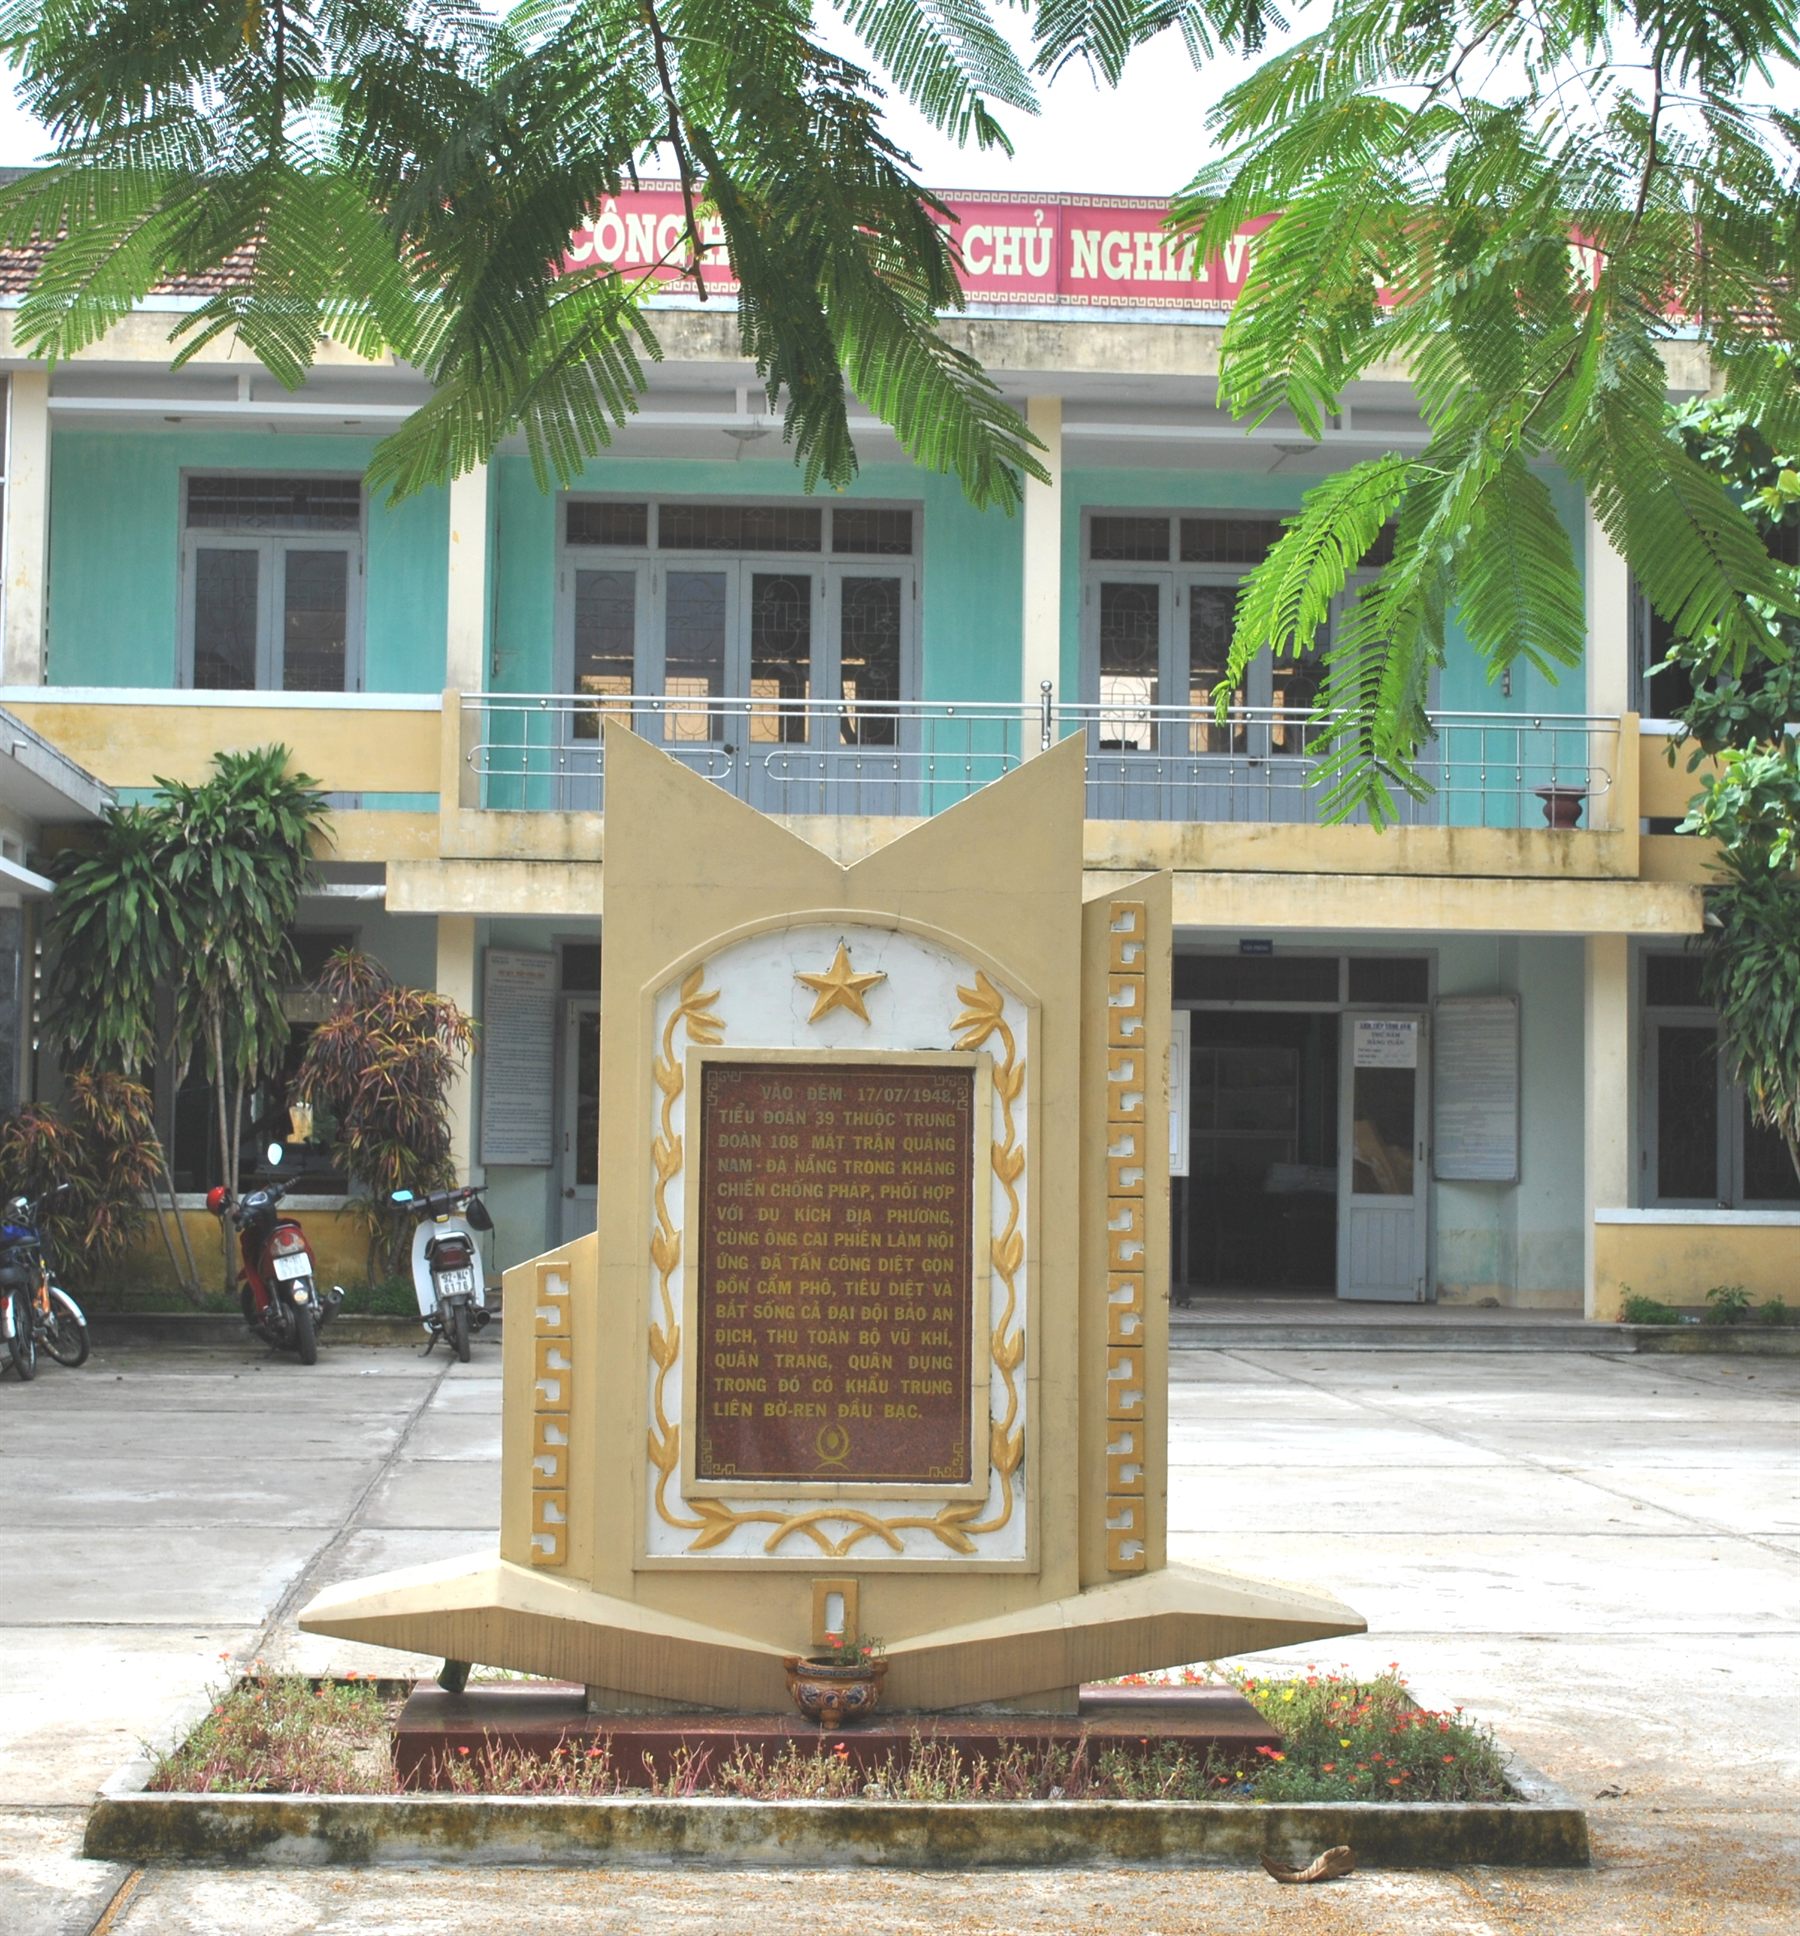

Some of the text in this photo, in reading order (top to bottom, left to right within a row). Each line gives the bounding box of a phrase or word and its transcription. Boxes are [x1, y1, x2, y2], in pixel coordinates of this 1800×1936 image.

[962, 208, 1053, 277] CHỦ
[762, 1082, 793, 1101] VÀO
[806, 1083, 843, 1102] ĐÊM
[719, 1102, 956, 1128] TIỂU ĐOÀN 39 THUỘC TRUNG
[718, 1131, 761, 1148] ĐOÀN
[770, 1135, 798, 1149] 108
[854, 1133, 895, 1153] TRẬN
[903, 1132, 956, 1152] QUẢNG
[718, 1158, 752, 1173] NAM
[766, 1156, 787, 1173] ĐÀ
[843, 1160, 895, 1175] TRONG
[902, 1158, 956, 1176] KHÁNG
[717, 1178, 955, 1202] CHIẾN CHỐNG PHÁP, PHỐI HỢP
[717, 1204, 954, 1226] VỚI DU KÍCH ĐỊA PHƯƠNG,
[717, 1228, 955, 1251] CÙNG ÔNG CAI PHIÊN LÀM NỘI
[716, 1251, 954, 1276] ỨNG ĐÃ TẤN CÔNG DIỆT GỌN
[716, 1273, 749, 1294] ĐỒN
[757, 1274, 792, 1295] CẨM
[844, 1278, 880, 1296] TIÊU
[888, 1279, 925, 1299] DIỆT
[933, 1280, 953, 1297] VÀ
[753, 1300, 795, 1320] SỐNG
[827, 1305, 855, 1323] ĐẠI
[861, 1303, 888, 1323] ĐỘI
[932, 1306, 953, 1321] AN
[715, 1326, 953, 1348] ĐỊCH, THU TOÀN BỘ VŨ KHÍ,
[714, 1350, 953, 1372] QUÂN TRANG, QUÂN DỤNG
[714, 1372, 953, 1395] TRONG ĐÓ CÓ KHẨU TRUNG
[714, 1399, 753, 1417] LIÊN
[884, 1404, 922, 1422] BẠC.
